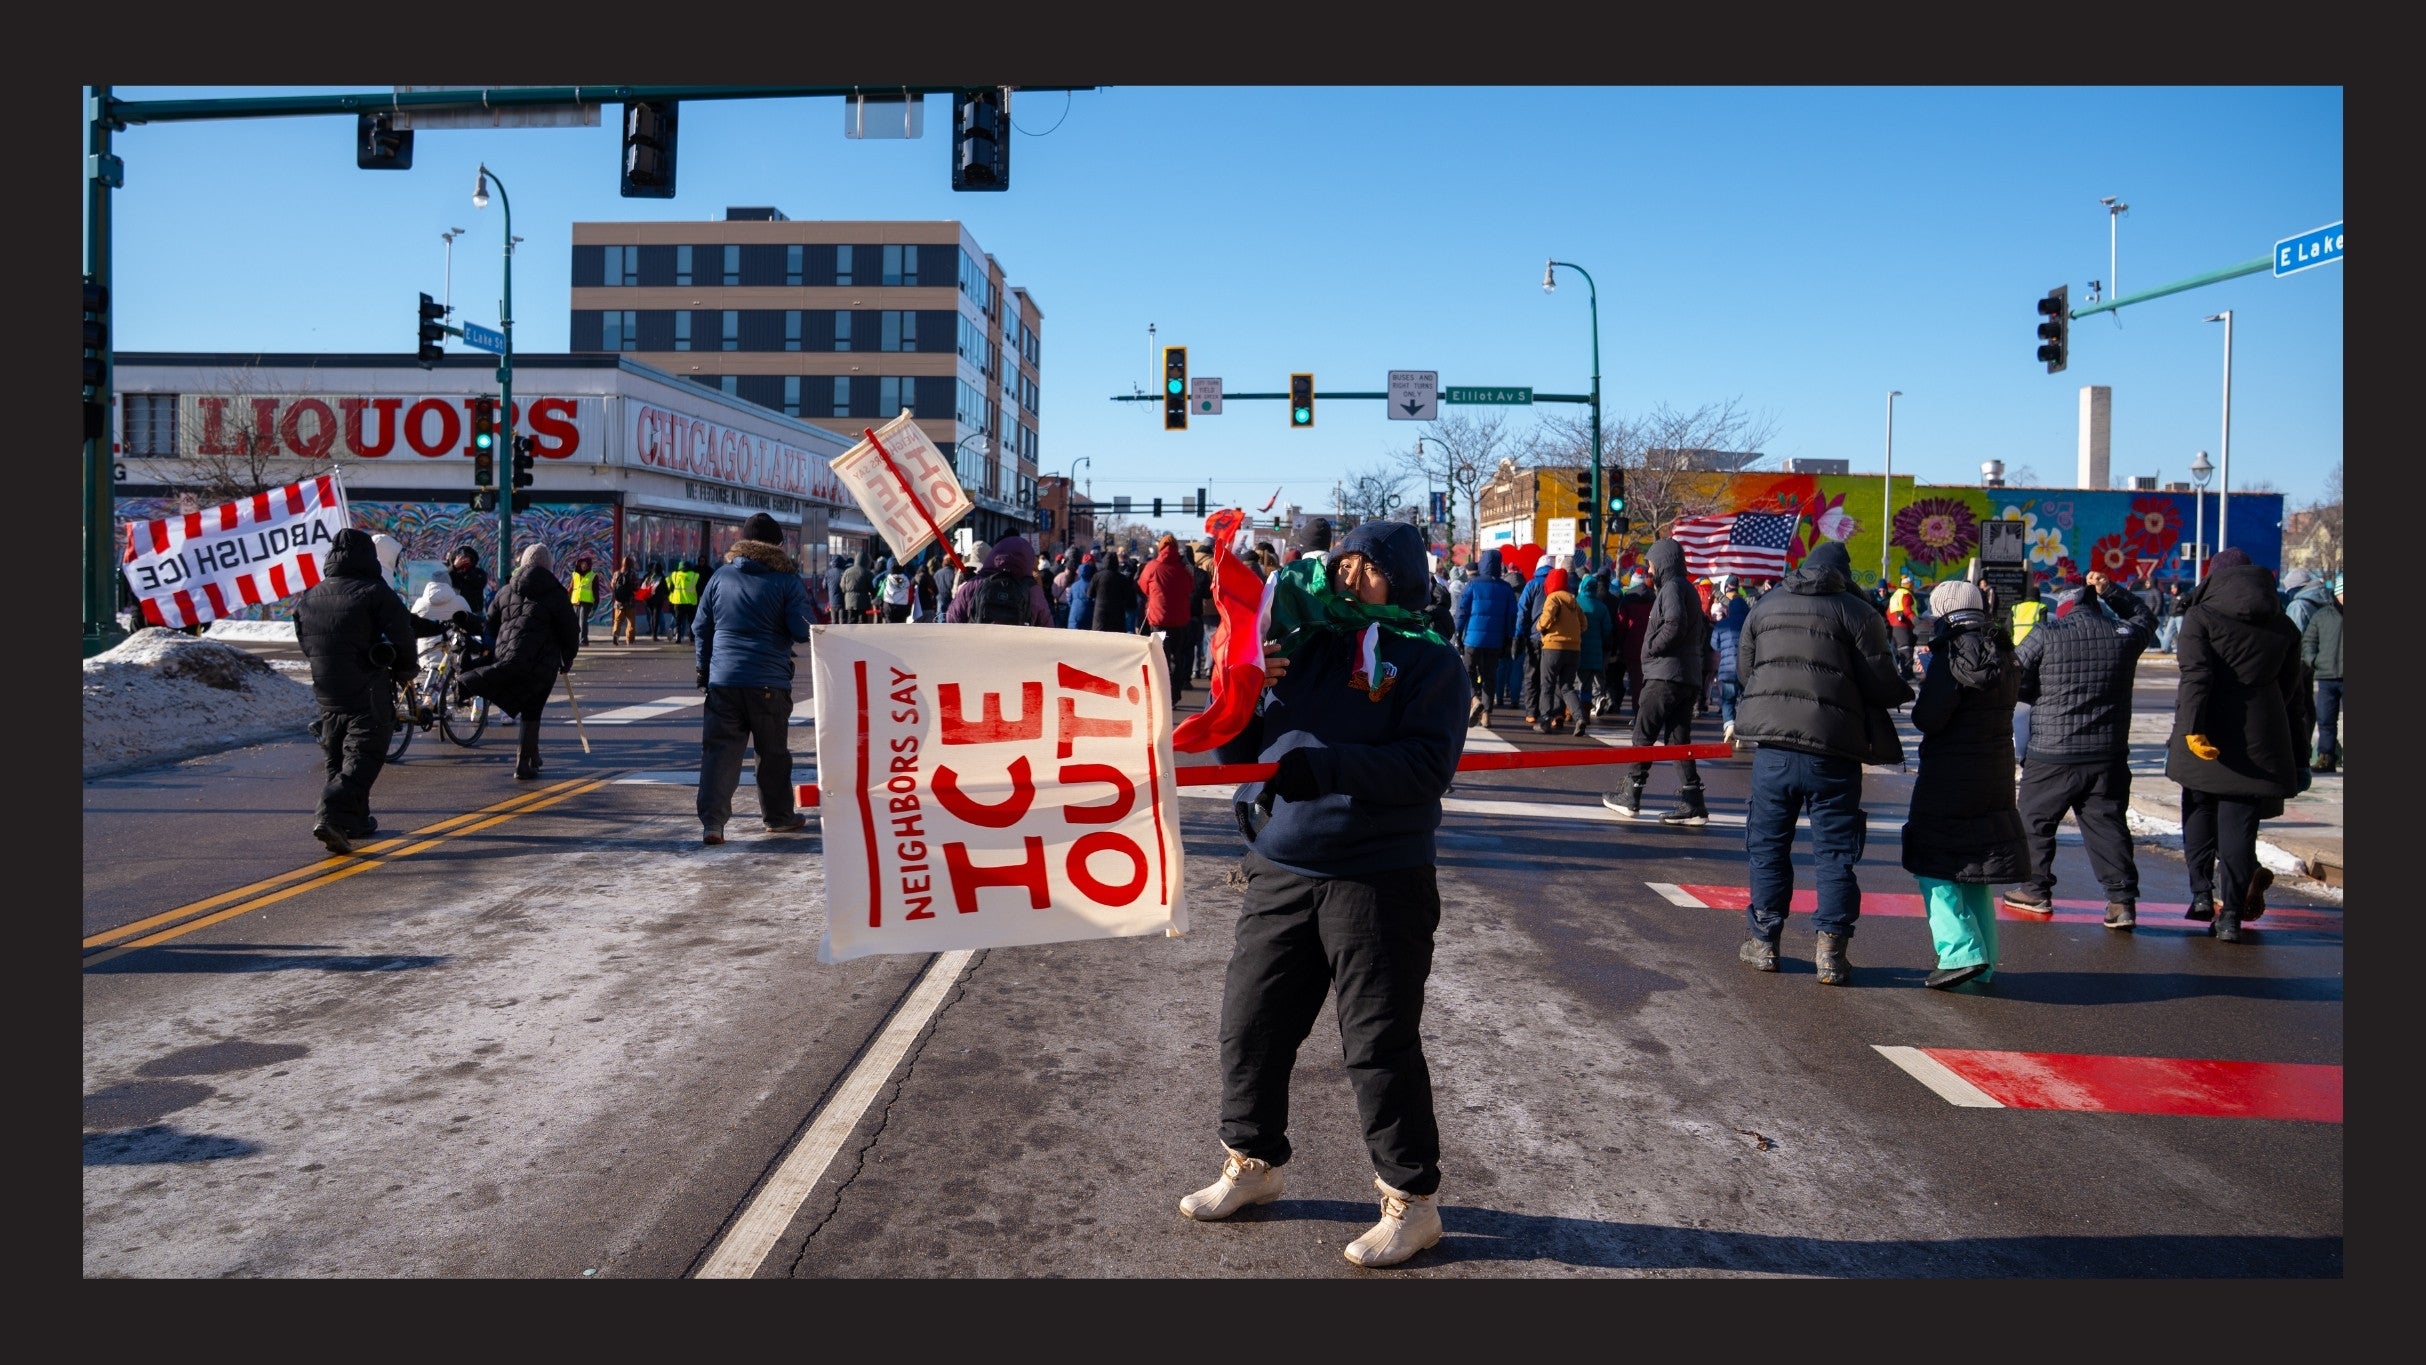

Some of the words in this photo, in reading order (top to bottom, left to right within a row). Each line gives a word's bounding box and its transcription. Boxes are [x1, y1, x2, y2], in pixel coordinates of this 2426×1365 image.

[2281, 246, 2292, 267] E
[465, 327, 471, 340] E
[473, 330, 492, 346] Lake
[495, 337, 504, 350] St
[1452, 391, 1492, 401] Elliot
[1496, 391, 1514, 401] Av
[1518, 391, 1526, 401] S
[890, 666, 919, 724] SAY
[931, 681, 1051, 914] ICE
[1057, 661, 1148, 907] OUT!
[887, 735, 936, 921] NEIGHBORS
